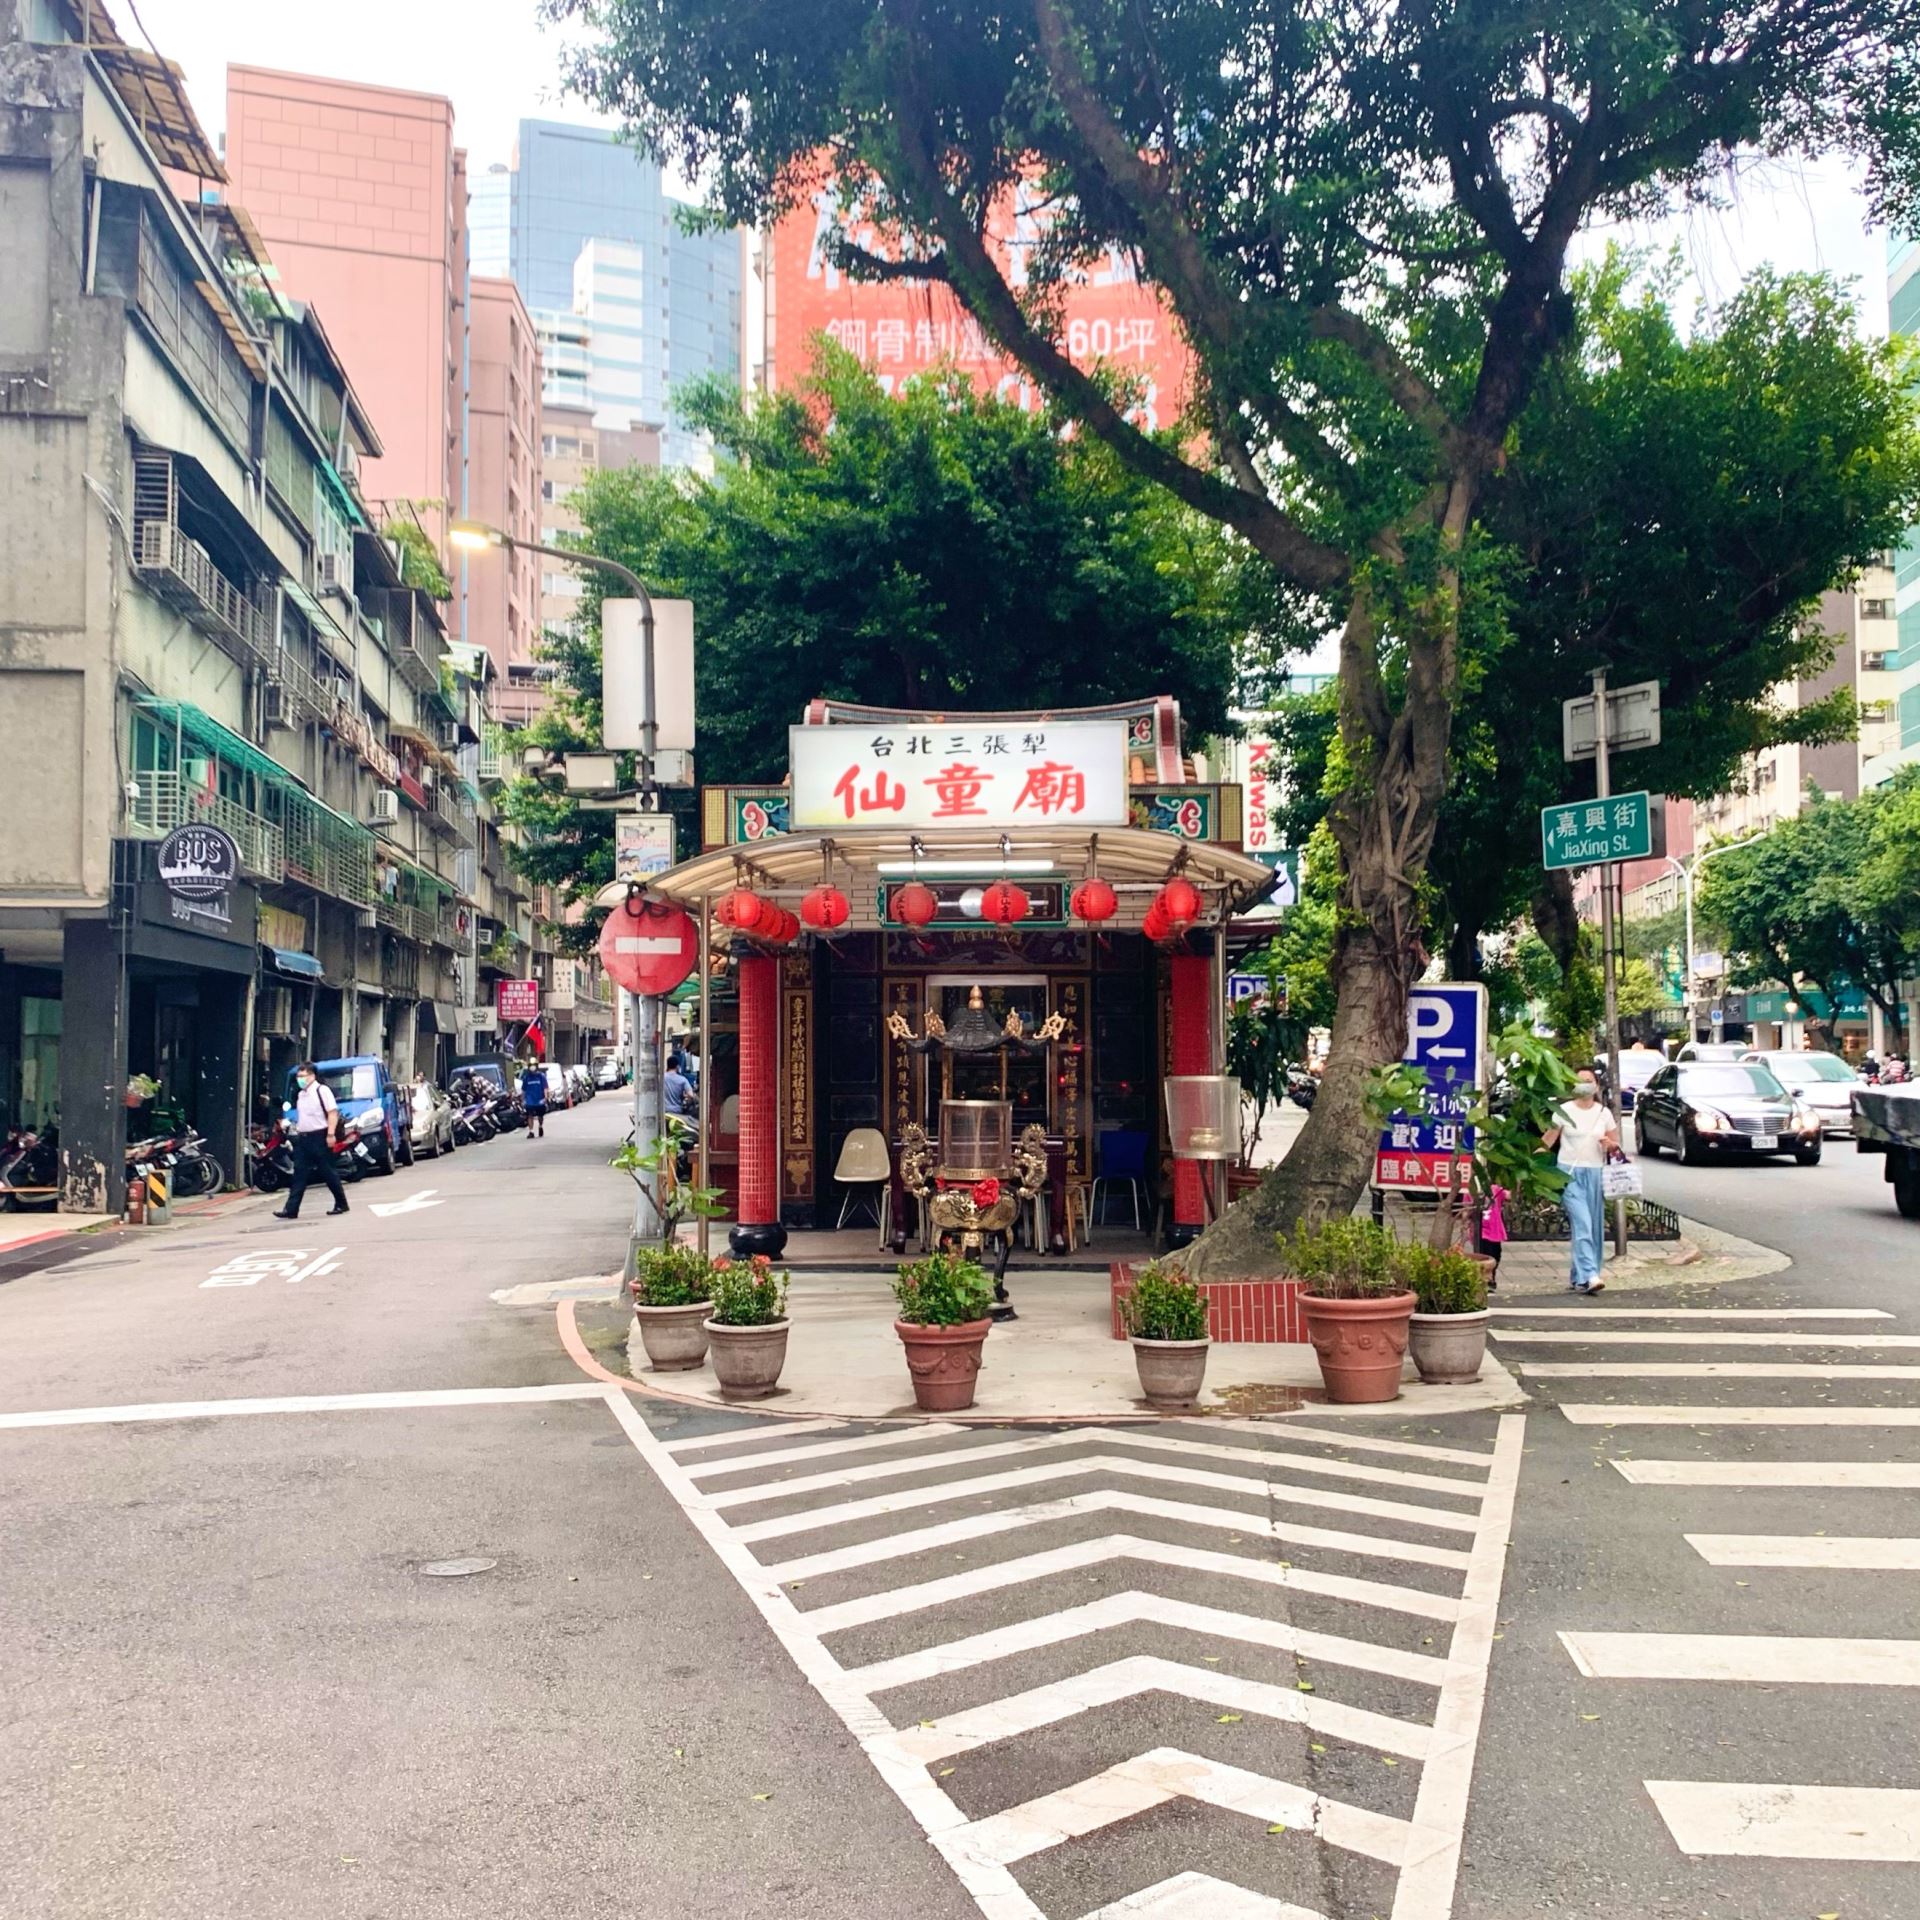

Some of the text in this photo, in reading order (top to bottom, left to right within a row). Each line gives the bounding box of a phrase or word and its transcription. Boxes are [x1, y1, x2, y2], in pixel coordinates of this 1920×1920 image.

[870, 733, 1048, 757] 台北三張犁
[833, 761, 1086, 818] 仙童廟
[1556, 802, 1638, 838] 嘉興街
[175, 838, 221, 864] BOS
[1561, 834, 1631, 859] JiaXing St.
[1403, 996, 1454, 1060] P
